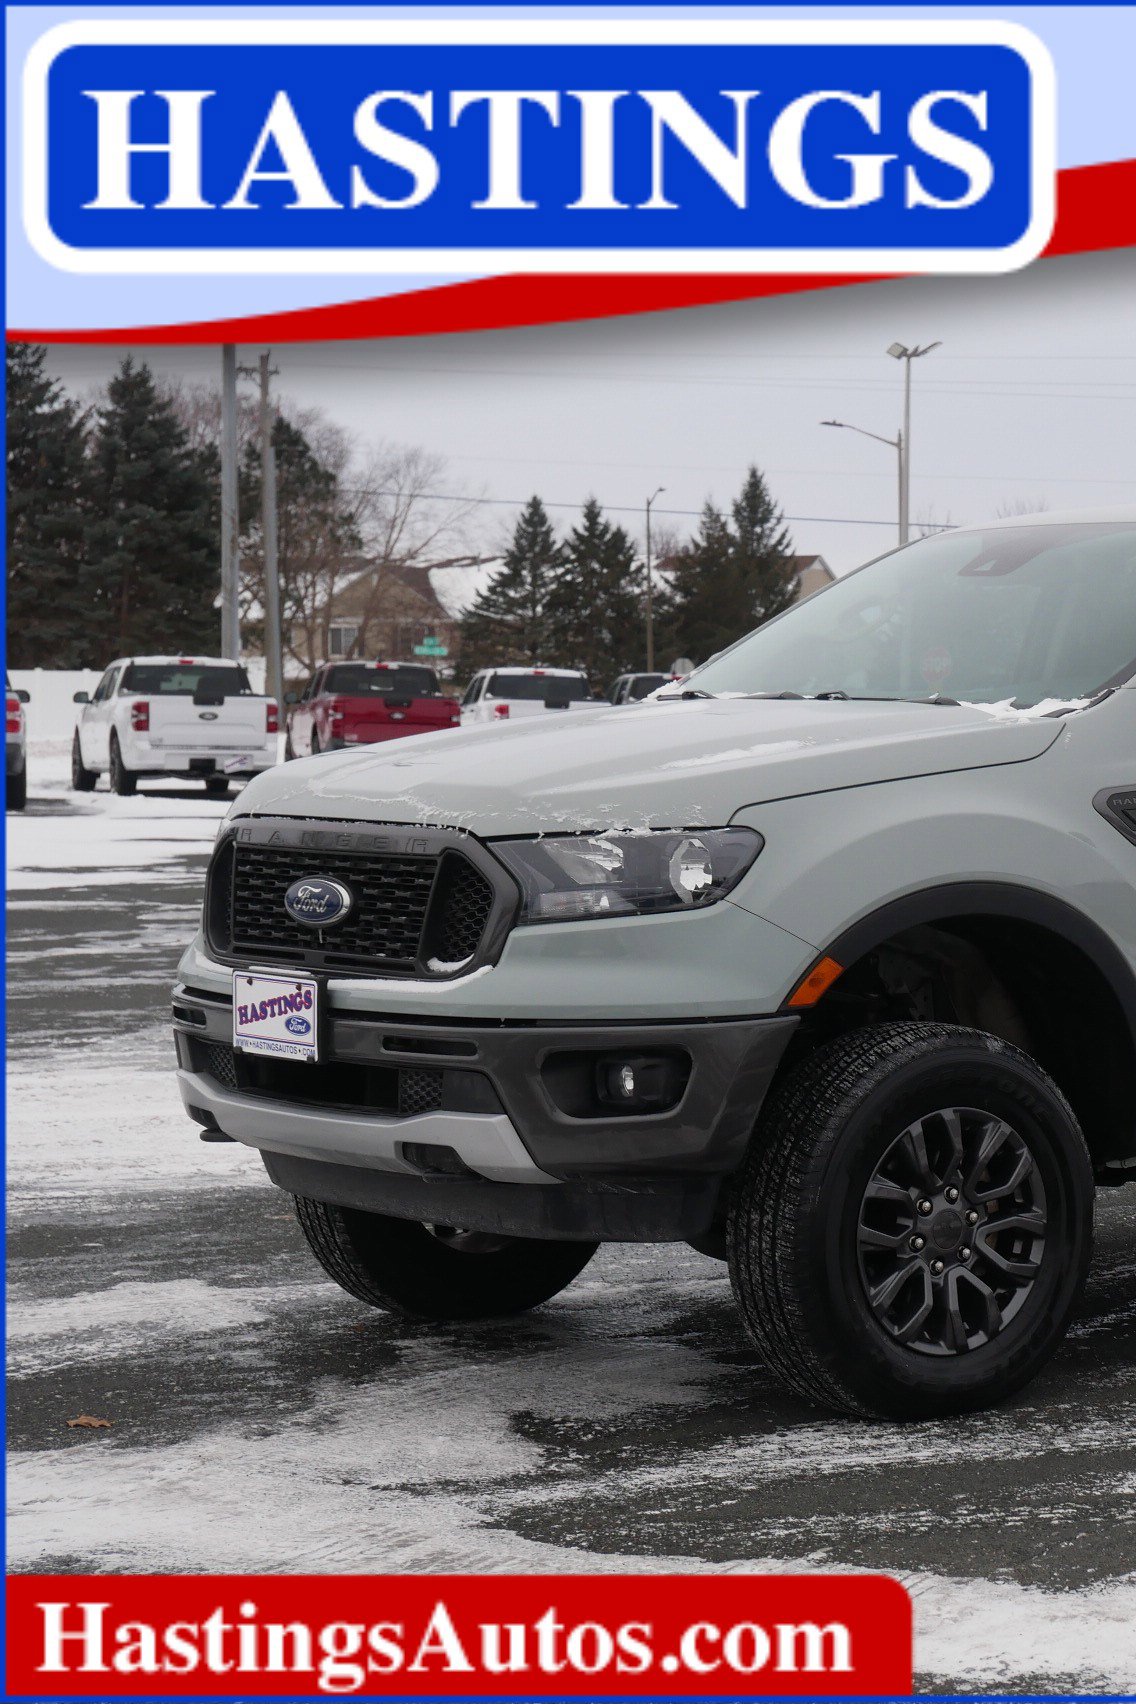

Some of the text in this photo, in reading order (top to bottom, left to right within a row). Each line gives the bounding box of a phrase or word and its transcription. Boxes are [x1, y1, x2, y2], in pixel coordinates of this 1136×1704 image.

[239, 828, 429, 853] RANGER
[293, 885, 330, 913] Ford
[238, 989, 313, 1026] HASTINGS
[288, 1016, 307, 1033] Ford
